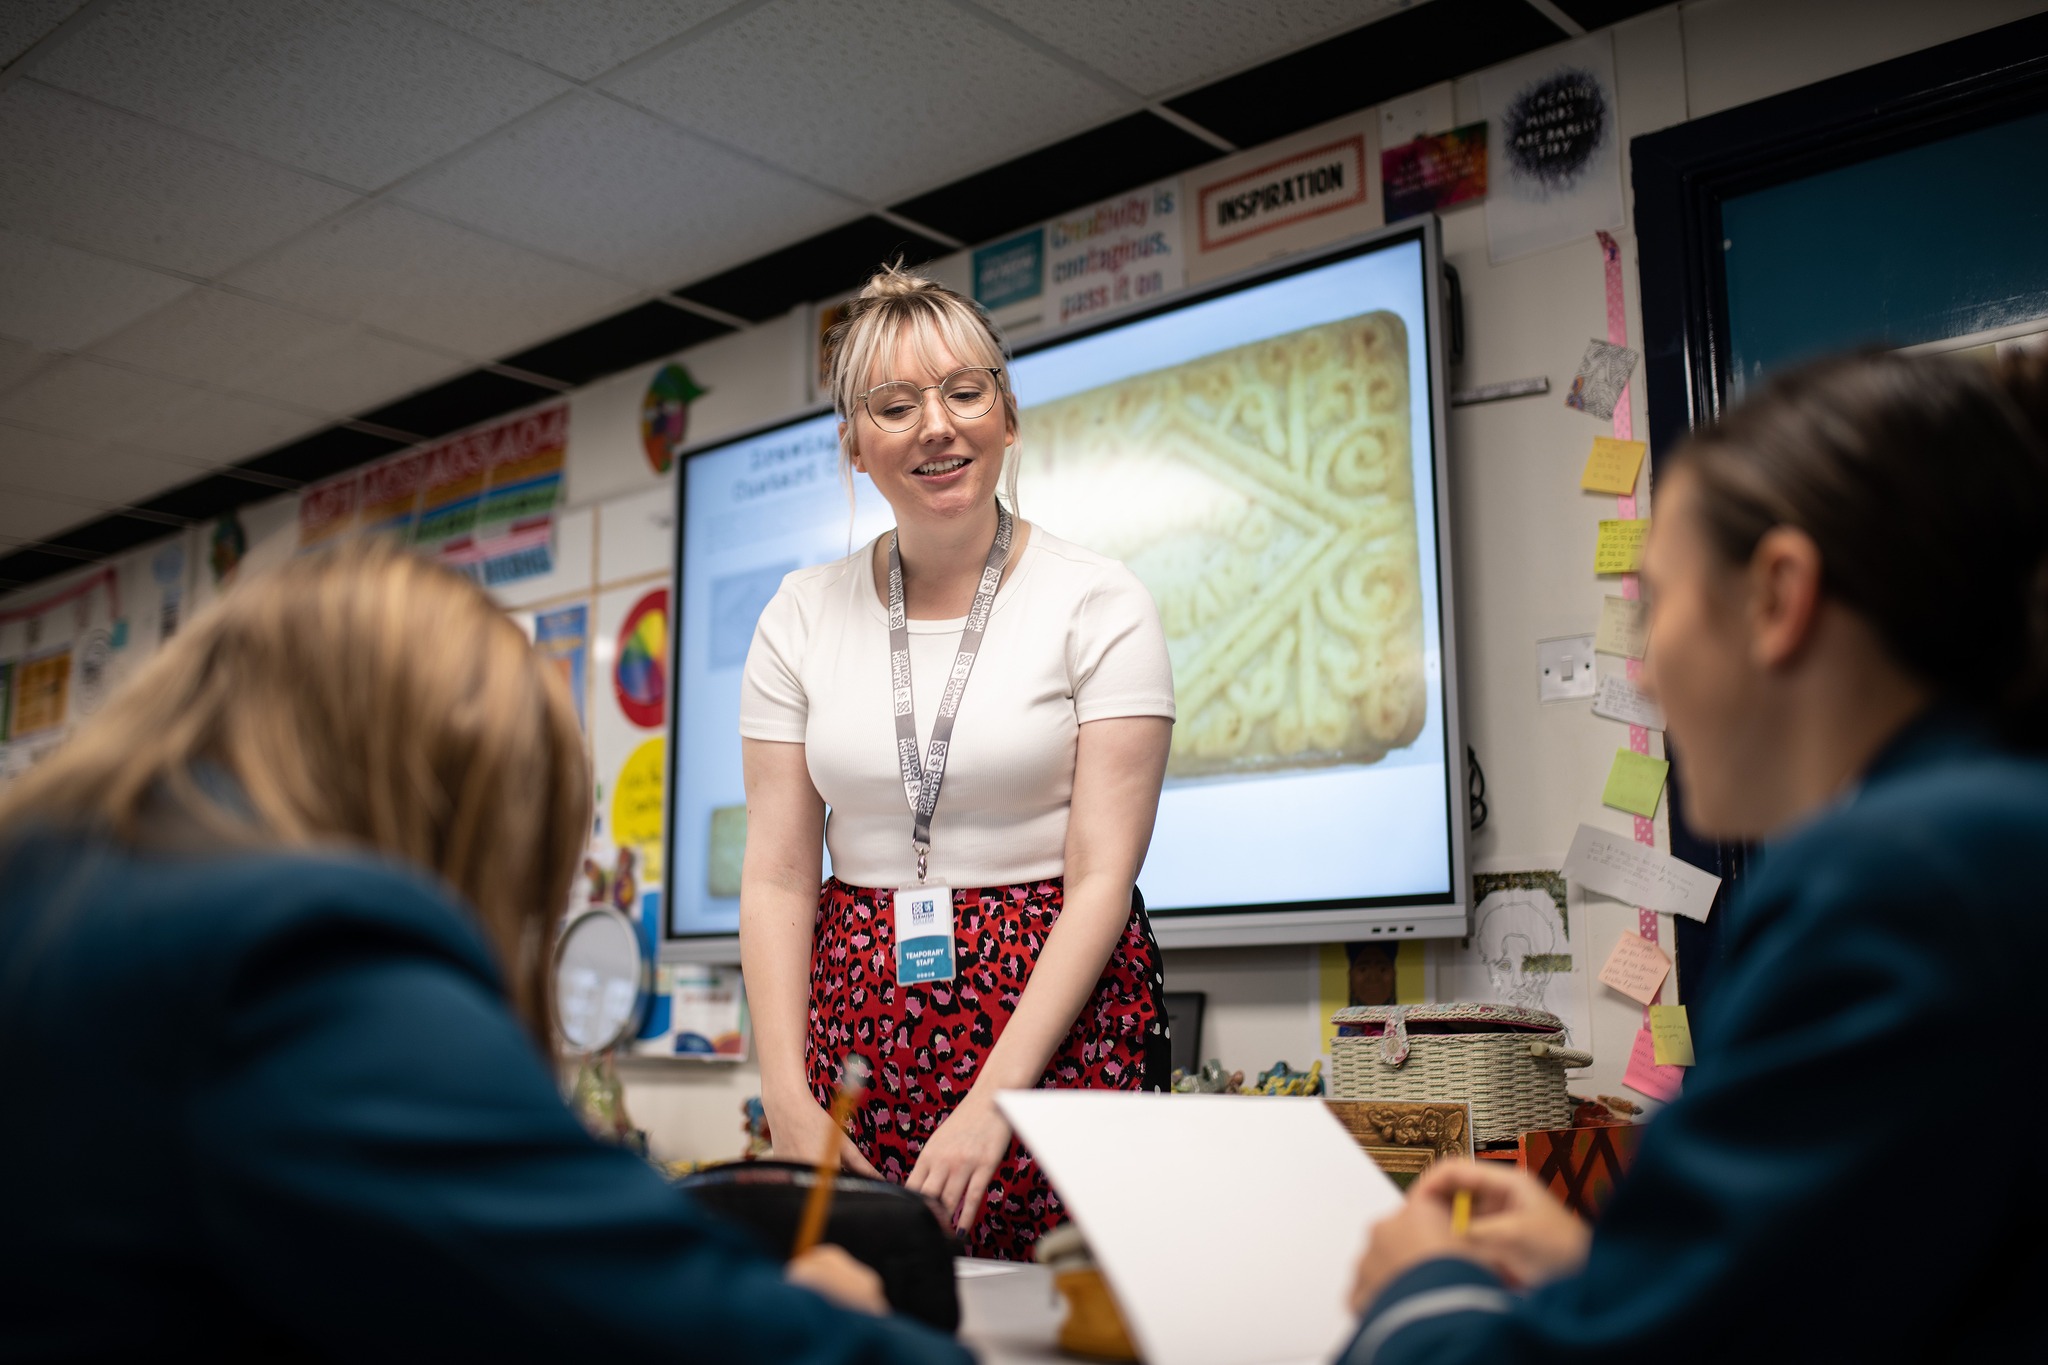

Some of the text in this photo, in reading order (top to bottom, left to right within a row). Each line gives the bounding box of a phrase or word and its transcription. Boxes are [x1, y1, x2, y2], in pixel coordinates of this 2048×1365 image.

[1526, 103, 1574, 128] MINDS
[1515, 131, 1543, 147] ARE
[1538, 139, 1572, 157] TIDY
[1217, 161, 1344, 227] INSPIRATION
[1052, 187, 1175, 248] Creativity is
[1060, 270, 1163, 322] pass it on
[966, 593, 983, 631] COLLEGE
[977, 595, 993, 633] SLEMISH
[892, 651, 902, 689] SLEMISH
[900, 648, 910, 687] COLLEGE
[938, 678, 955, 718] COLLEGE
[946, 679, 965, 718] SLEMISH
[899, 738, 912, 781] SLEMISH
[907, 736, 921, 780] COLLEGE
[917, 770, 933, 815] COLLEGE
[925, 772, 942, 816] SLEMISH
[906, 948, 944, 960] TEMPORARY
[916, 958, 935, 967] STAFF
